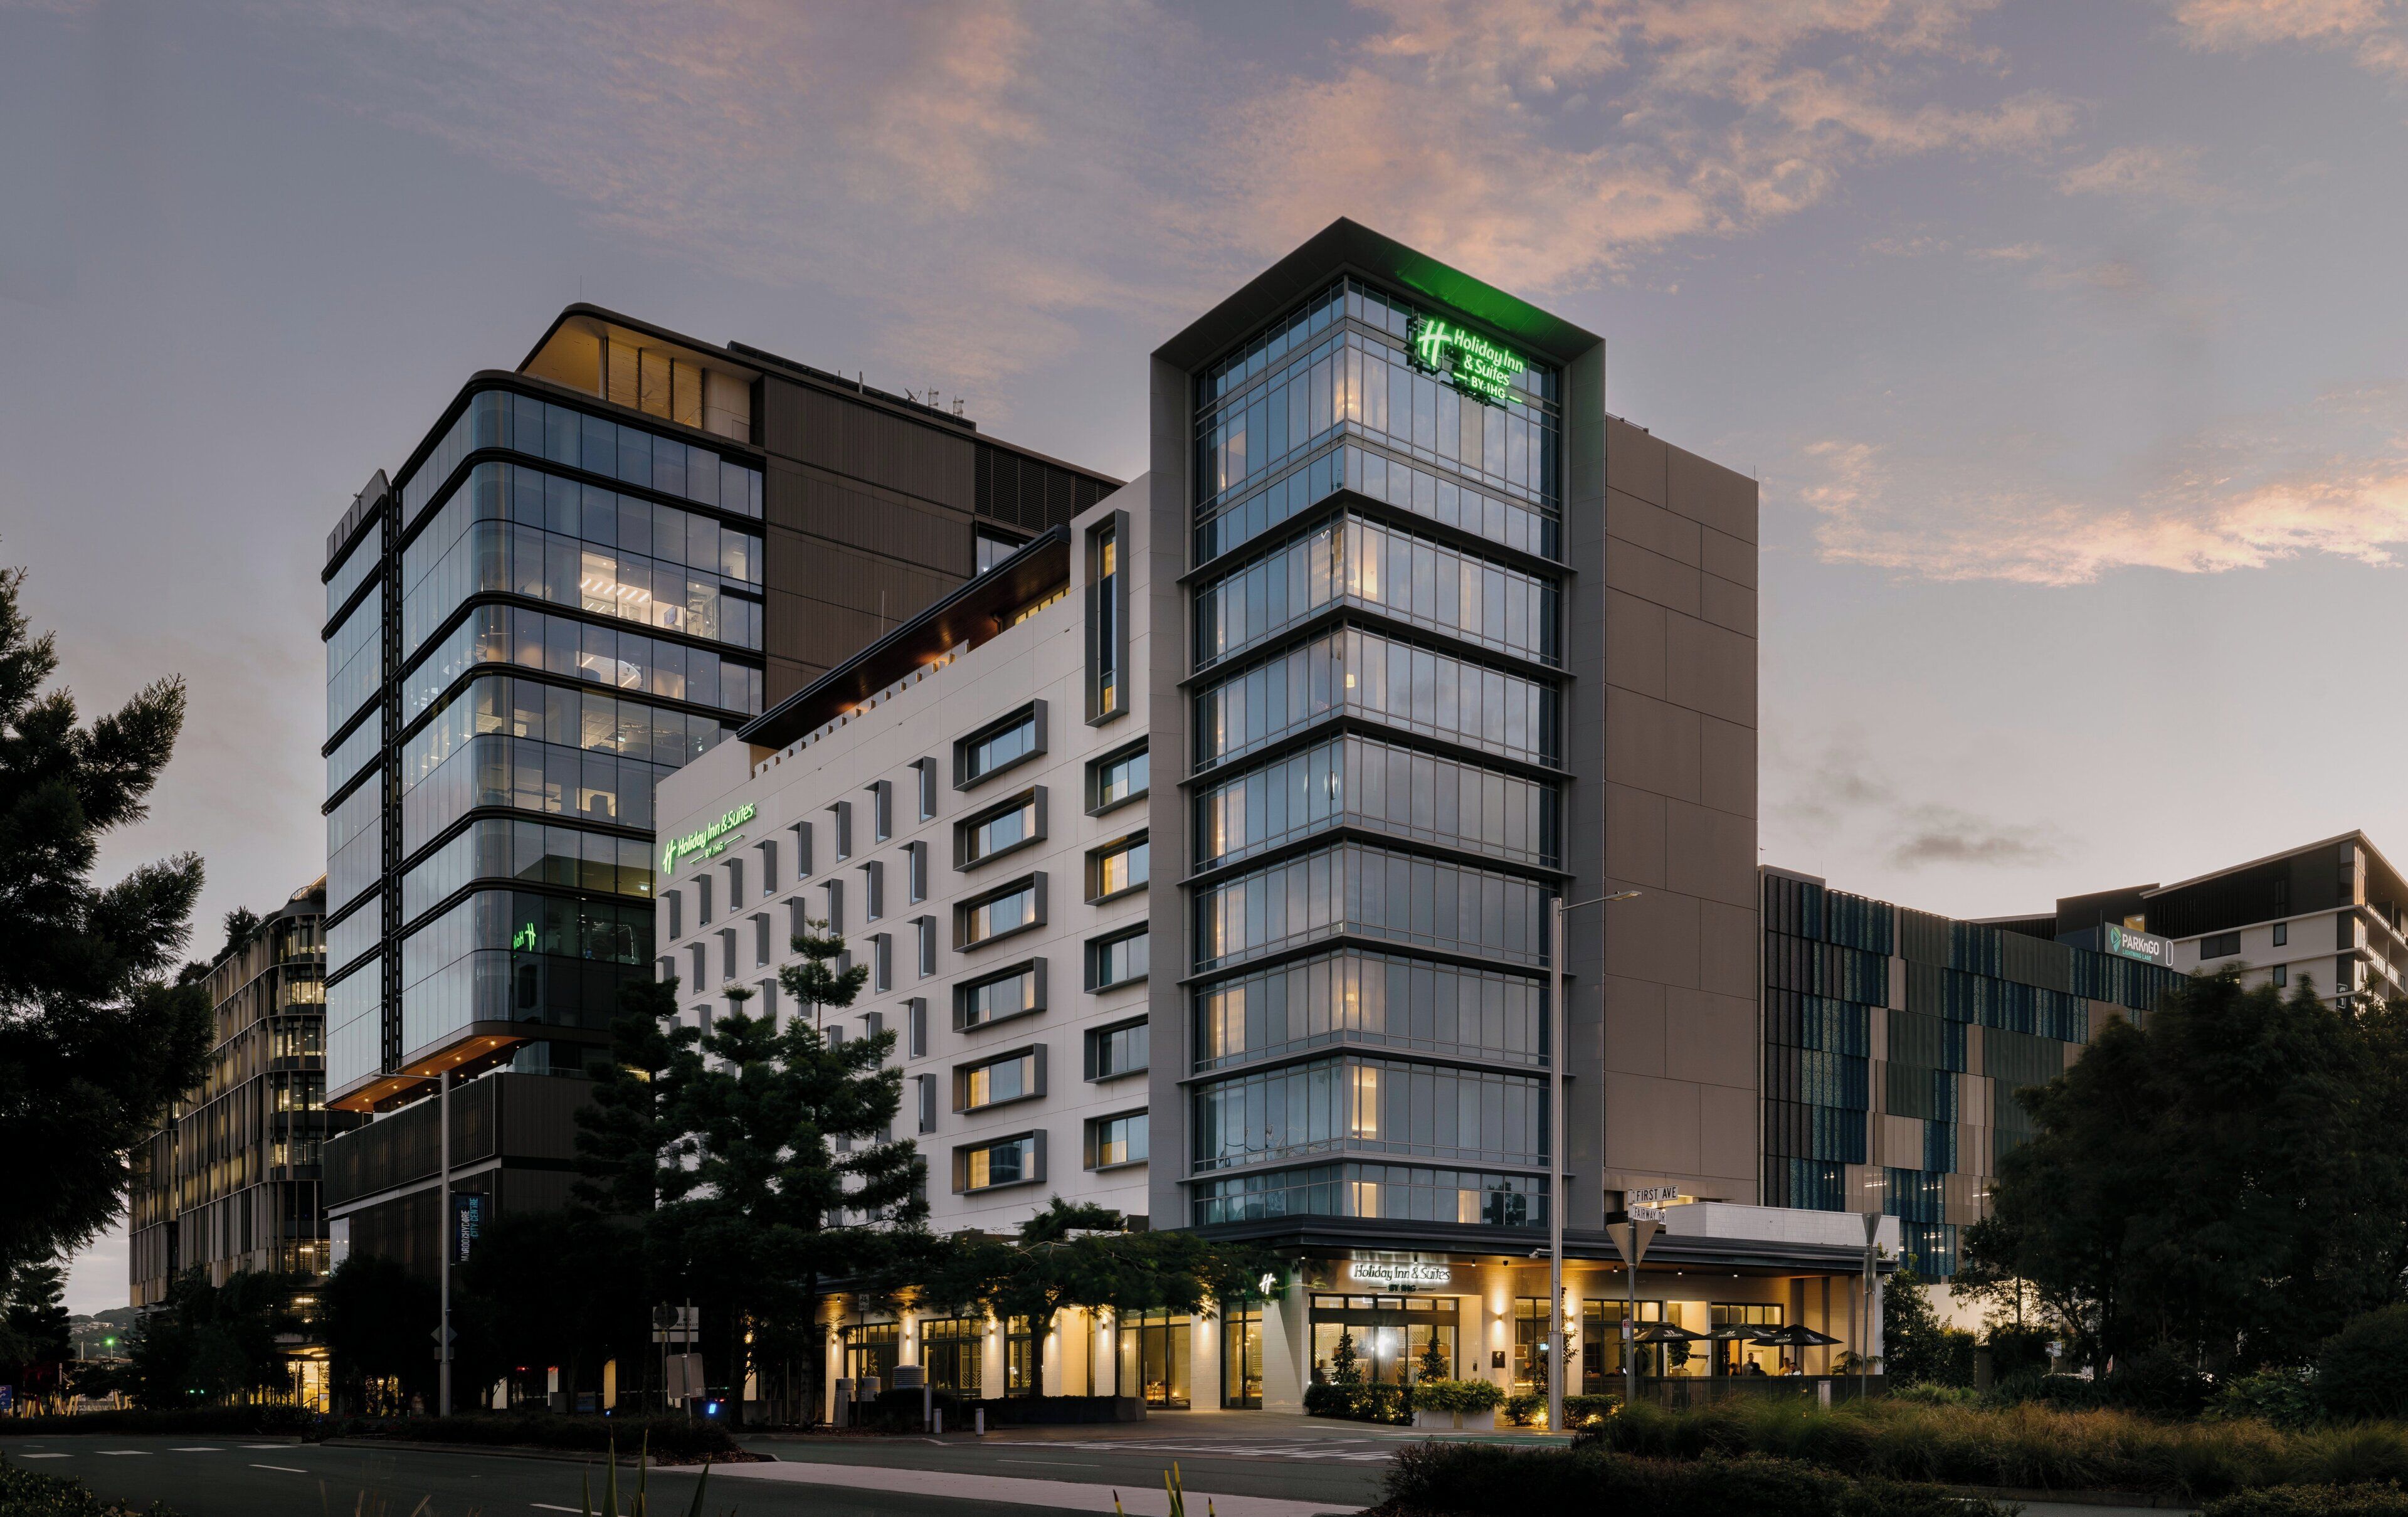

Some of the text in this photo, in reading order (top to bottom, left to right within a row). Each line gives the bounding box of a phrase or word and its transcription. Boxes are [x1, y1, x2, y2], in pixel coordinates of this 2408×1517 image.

[1454, 329, 1523, 374] Holiday Inn
[1464, 354, 1510, 386] & Suites
[1471, 376, 1506, 399] BY IHG
[678, 803, 754, 857] Holiday Inn & Suites
[705, 841, 724, 859] BY IHG
[2122, 934, 2160, 956] PARKnGO
[2122, 949, 2152, 961] LIGHTNING LANE
[1636, 1187, 1677, 1202] FIRST AVE
[470, 1198, 479, 1237] CITY CENTRE
[1634, 1207, 1665, 1224] FAIRWAY DR
[461, 1210, 470, 1262] MAROOCHYDORE
[1354, 1264, 1450, 1281] Holiday Inn & Suites
